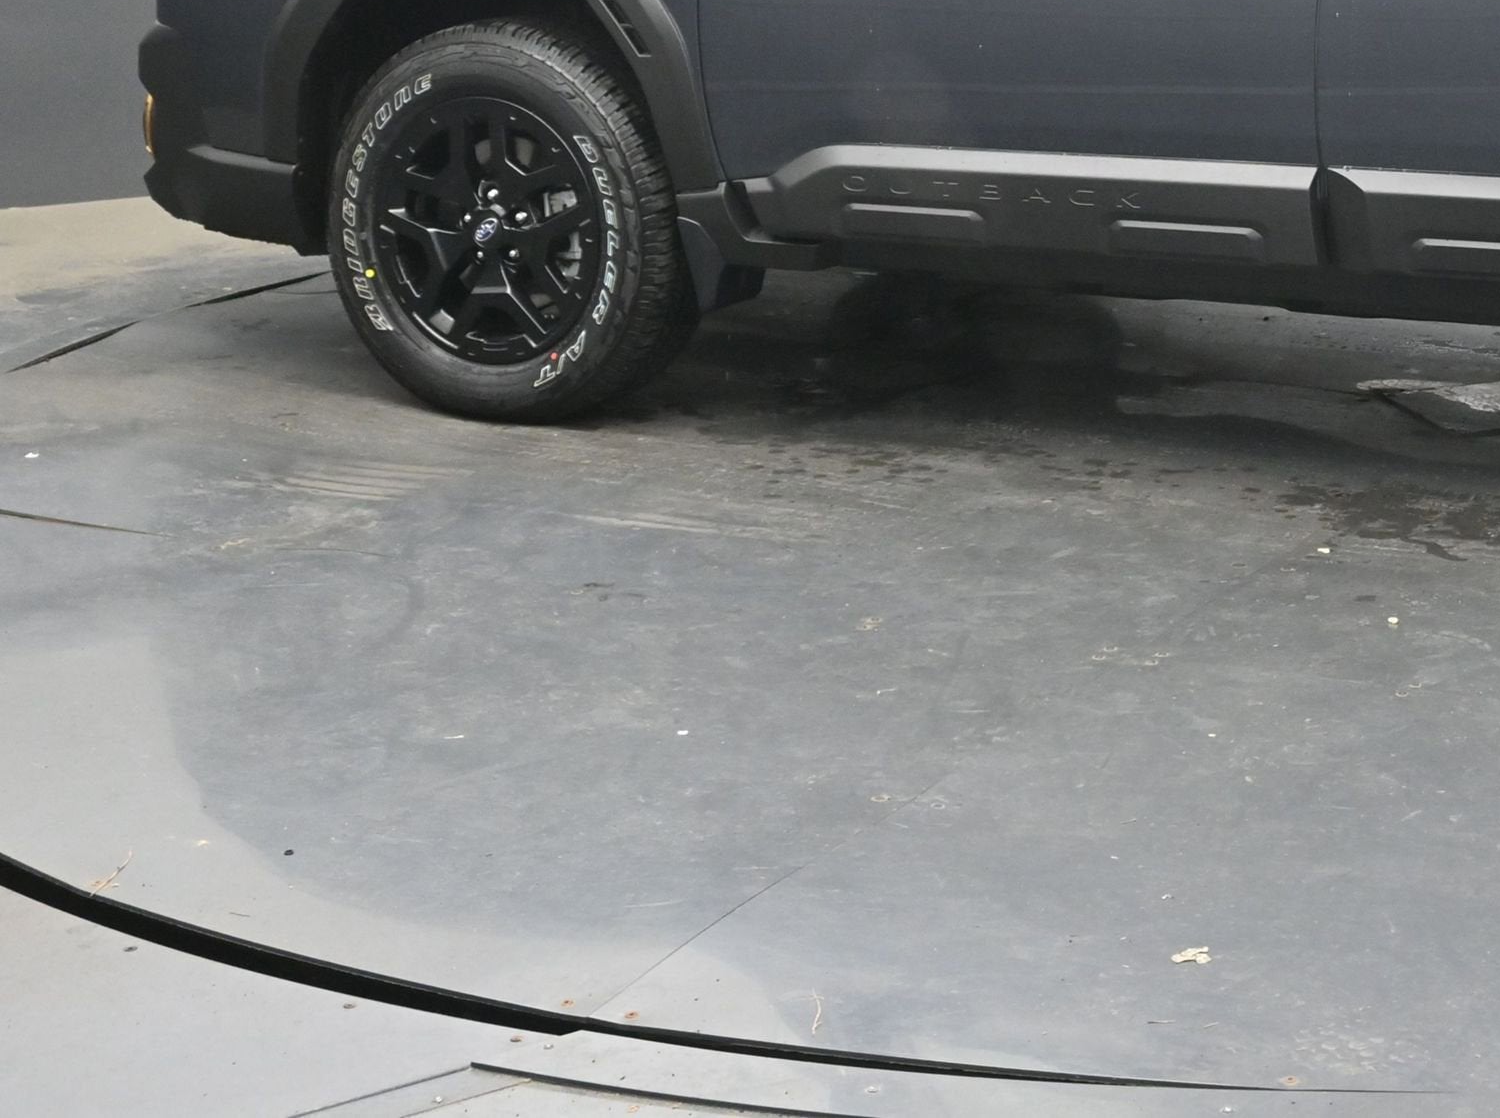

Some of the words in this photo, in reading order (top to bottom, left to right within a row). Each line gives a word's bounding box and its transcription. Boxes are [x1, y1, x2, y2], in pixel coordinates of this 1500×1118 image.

[342, 73, 433, 332] BRIDGESTONE
[573, 134, 620, 325] DUELER
[842, 175, 1141, 209] OUTBACK
